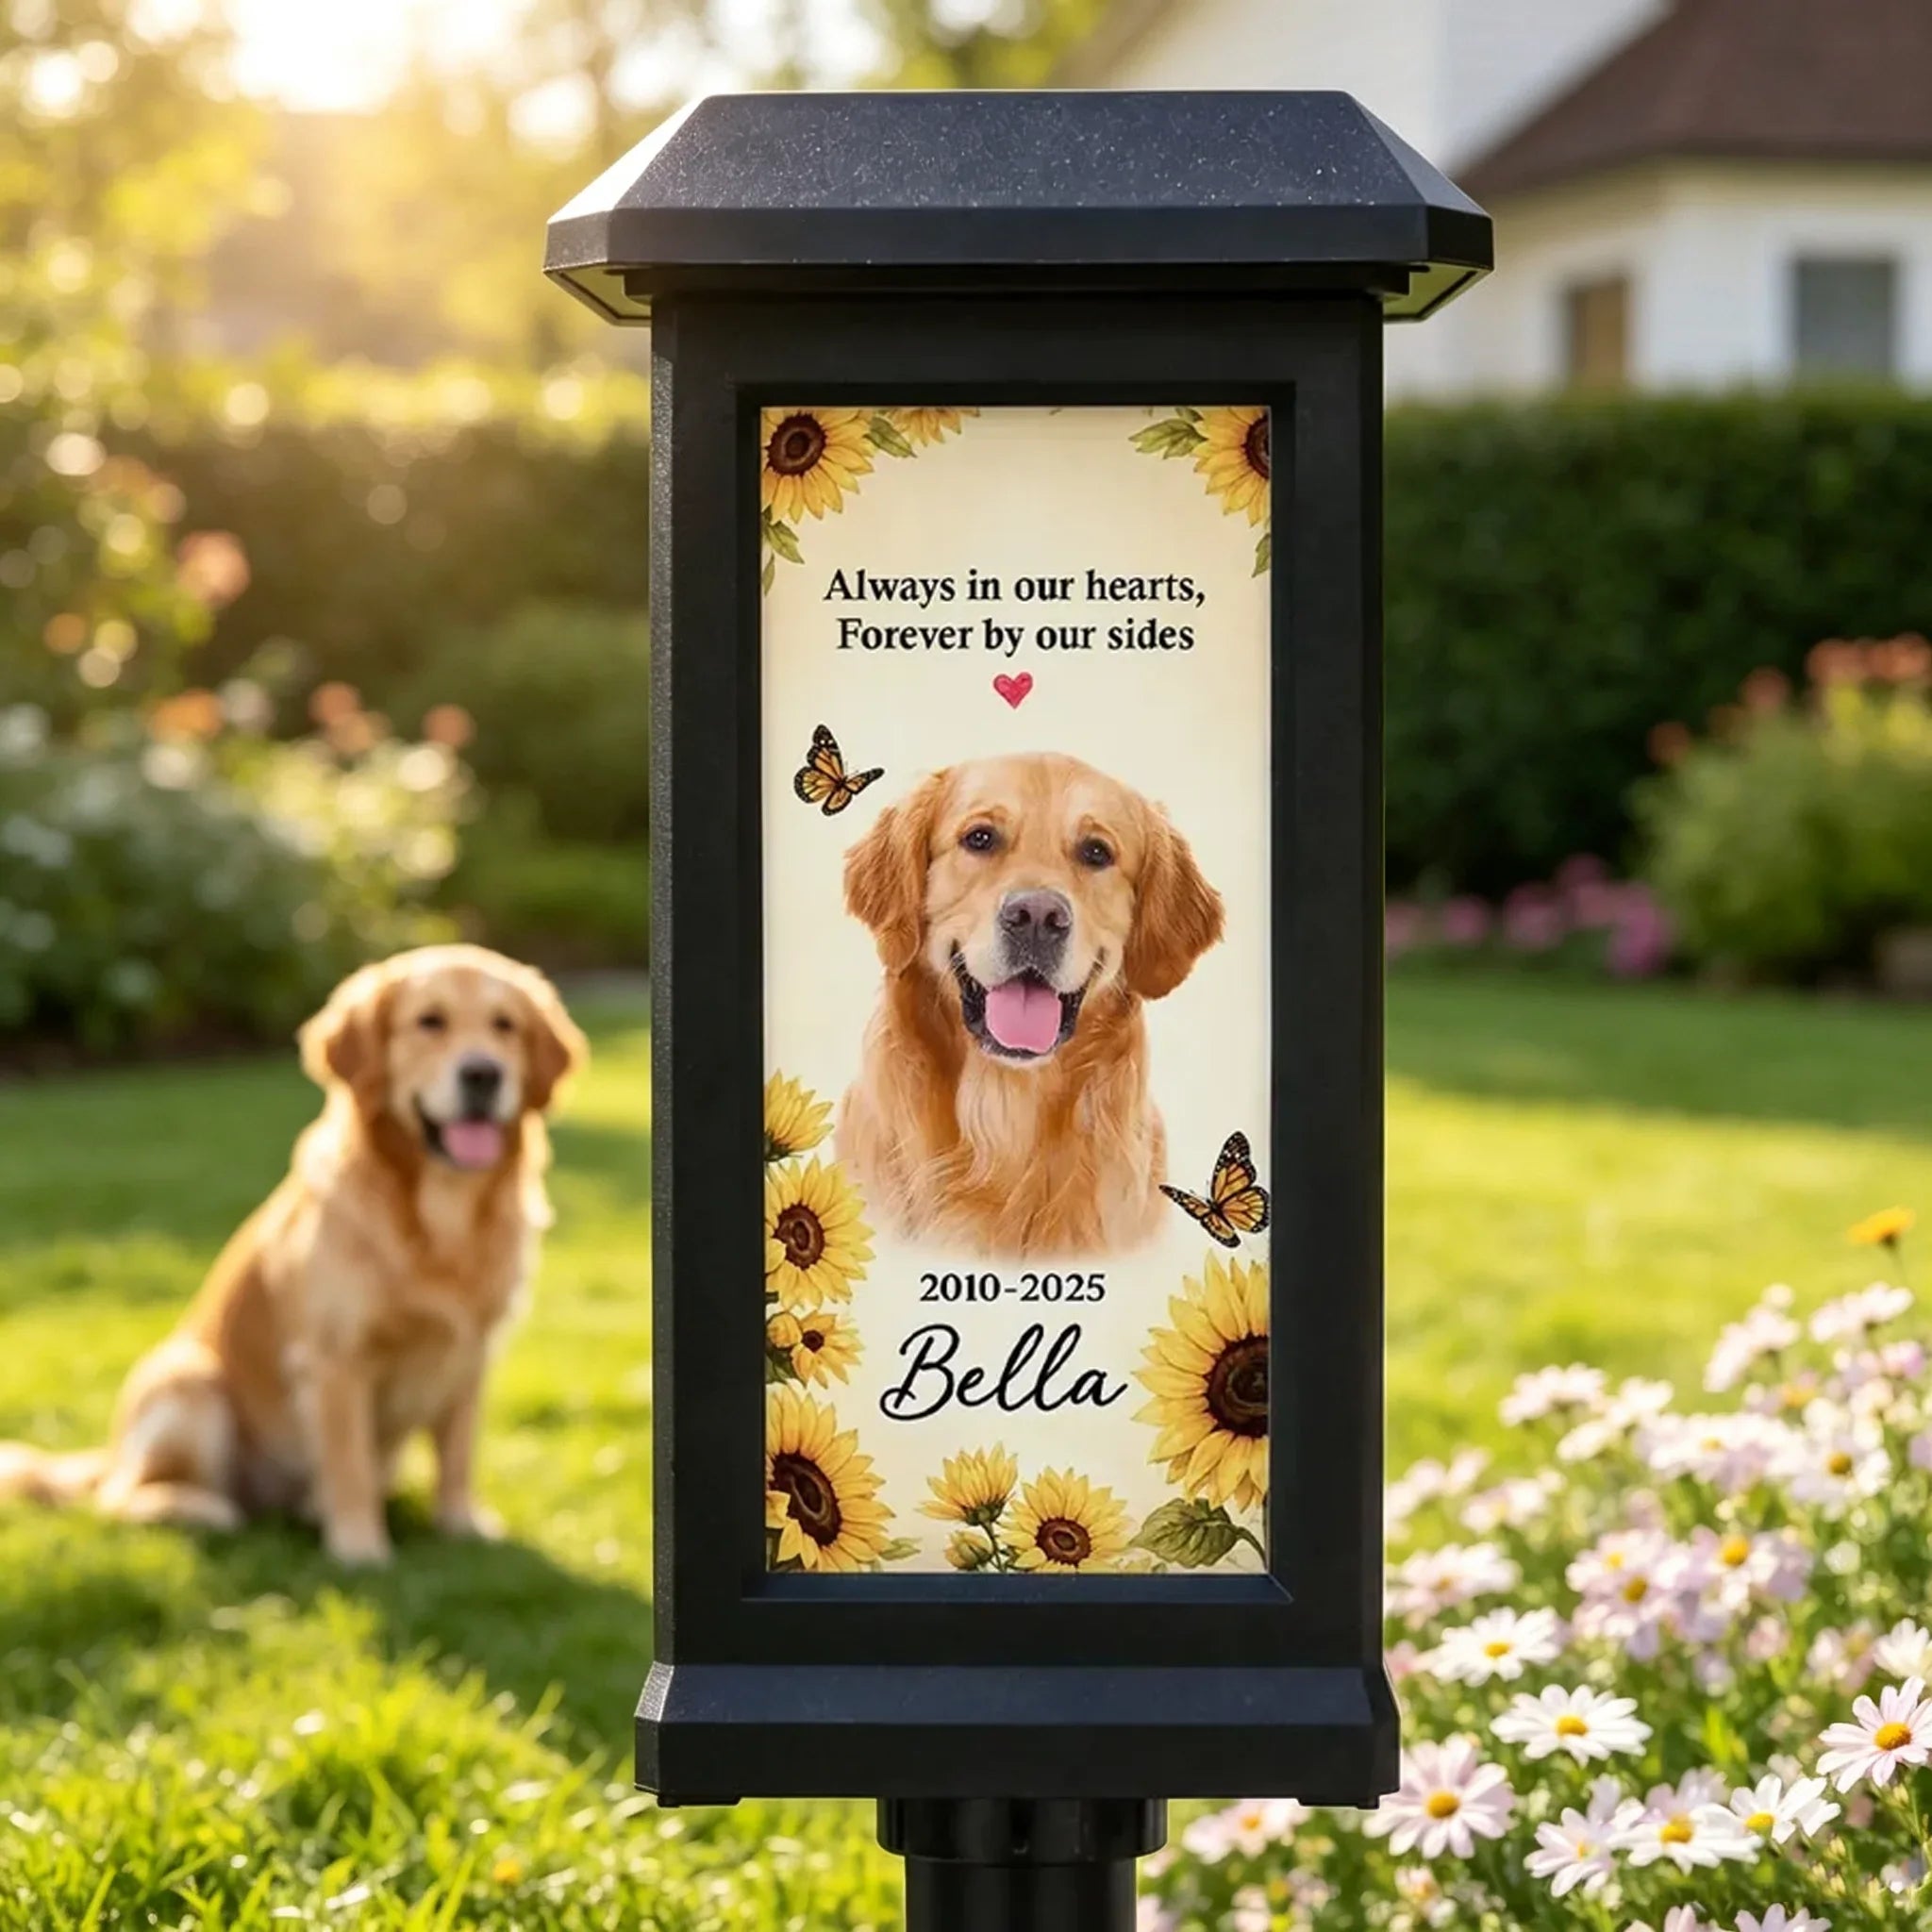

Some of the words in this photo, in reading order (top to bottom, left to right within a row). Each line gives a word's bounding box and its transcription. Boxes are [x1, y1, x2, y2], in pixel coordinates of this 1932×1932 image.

[824, 569, 956, 609] Always
[967, 568, 1002, 600] in
[1014, 576, 1075, 602] our
[1086, 569, 1206, 608] hearts,
[837, 617, 974, 650] Forever
[982, 617, 1024, 658] by
[1036, 625, 1097, 651] our
[1108, 617, 1195, 651] sides
[920, 1273, 1106, 1302] 2010-2025
[879, 1323, 1128, 1422] Bella
